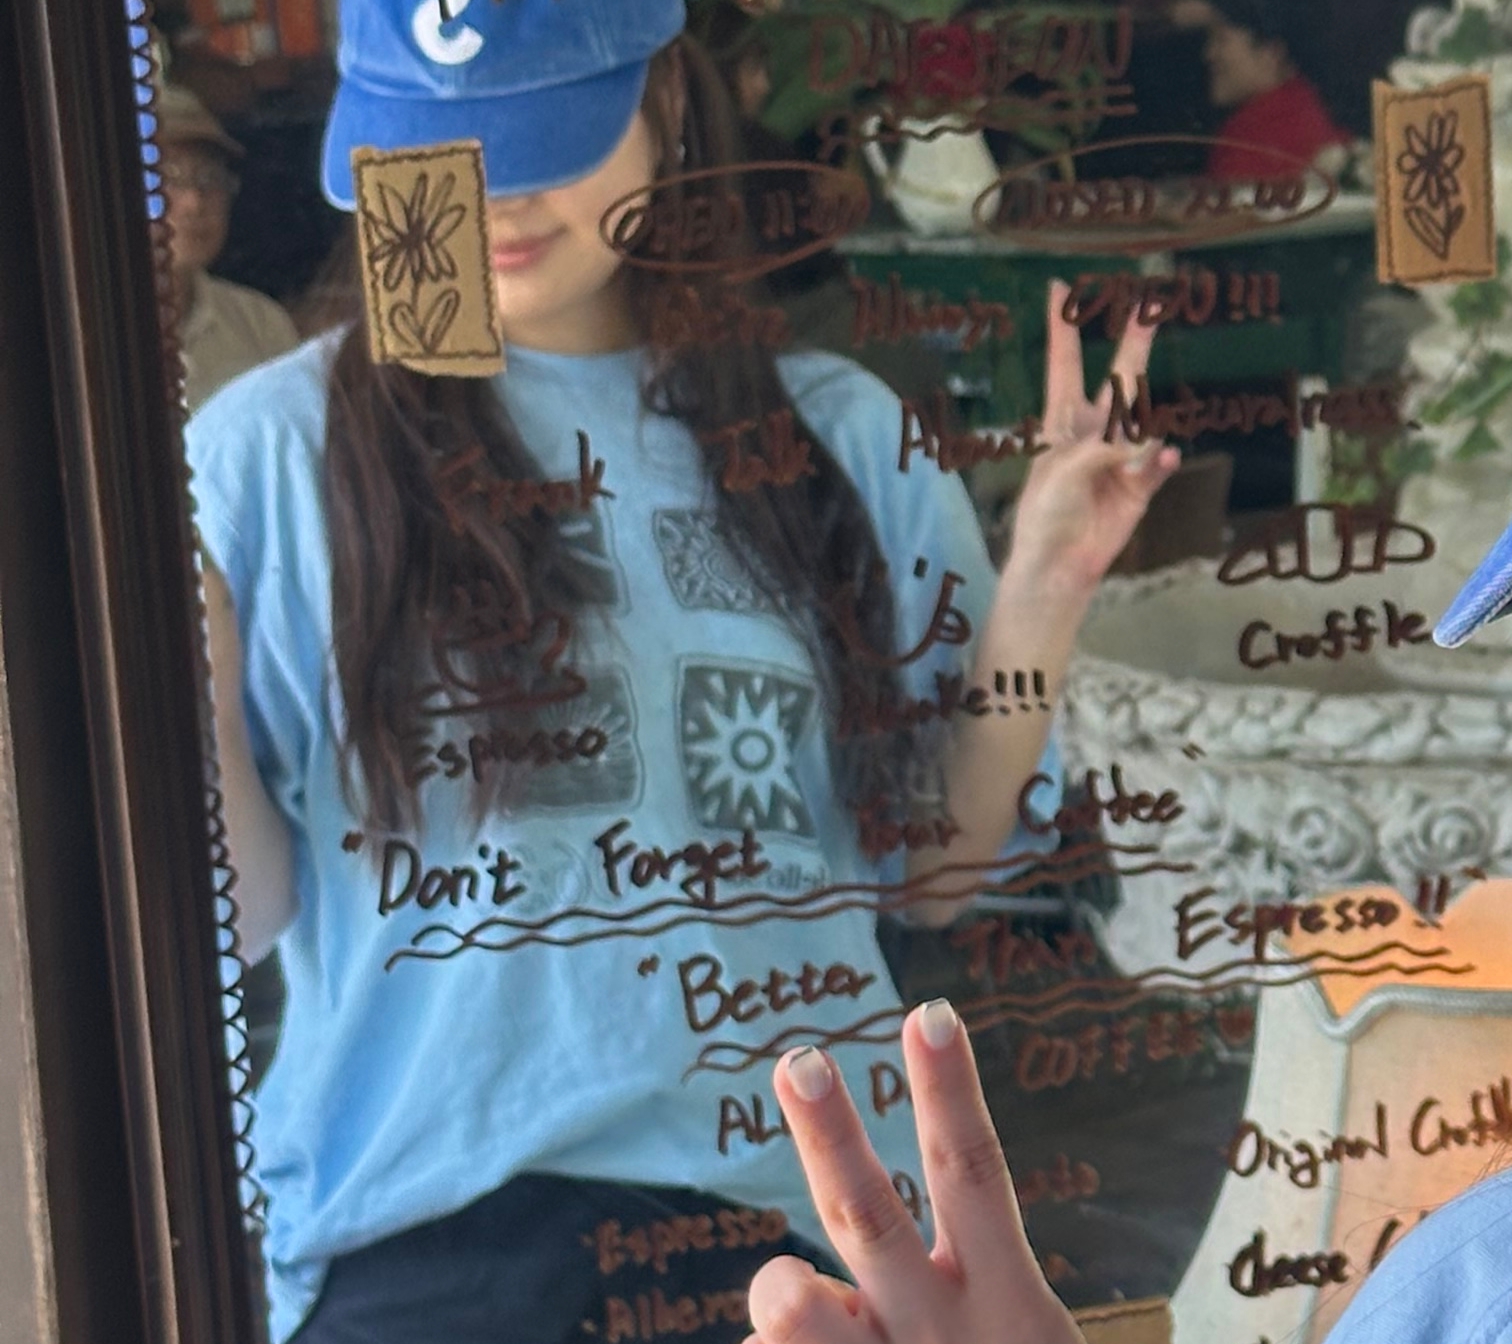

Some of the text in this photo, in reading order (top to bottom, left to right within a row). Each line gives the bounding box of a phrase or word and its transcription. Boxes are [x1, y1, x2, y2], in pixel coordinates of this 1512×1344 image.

[612, 196, 744, 253] OPEN
[998, 176, 1154, 230] CLOSED
[1238, 598, 1432, 670] Croffle
[594, 818, 772, 908] Forget
[595, 1208, 789, 1275] Espresso
